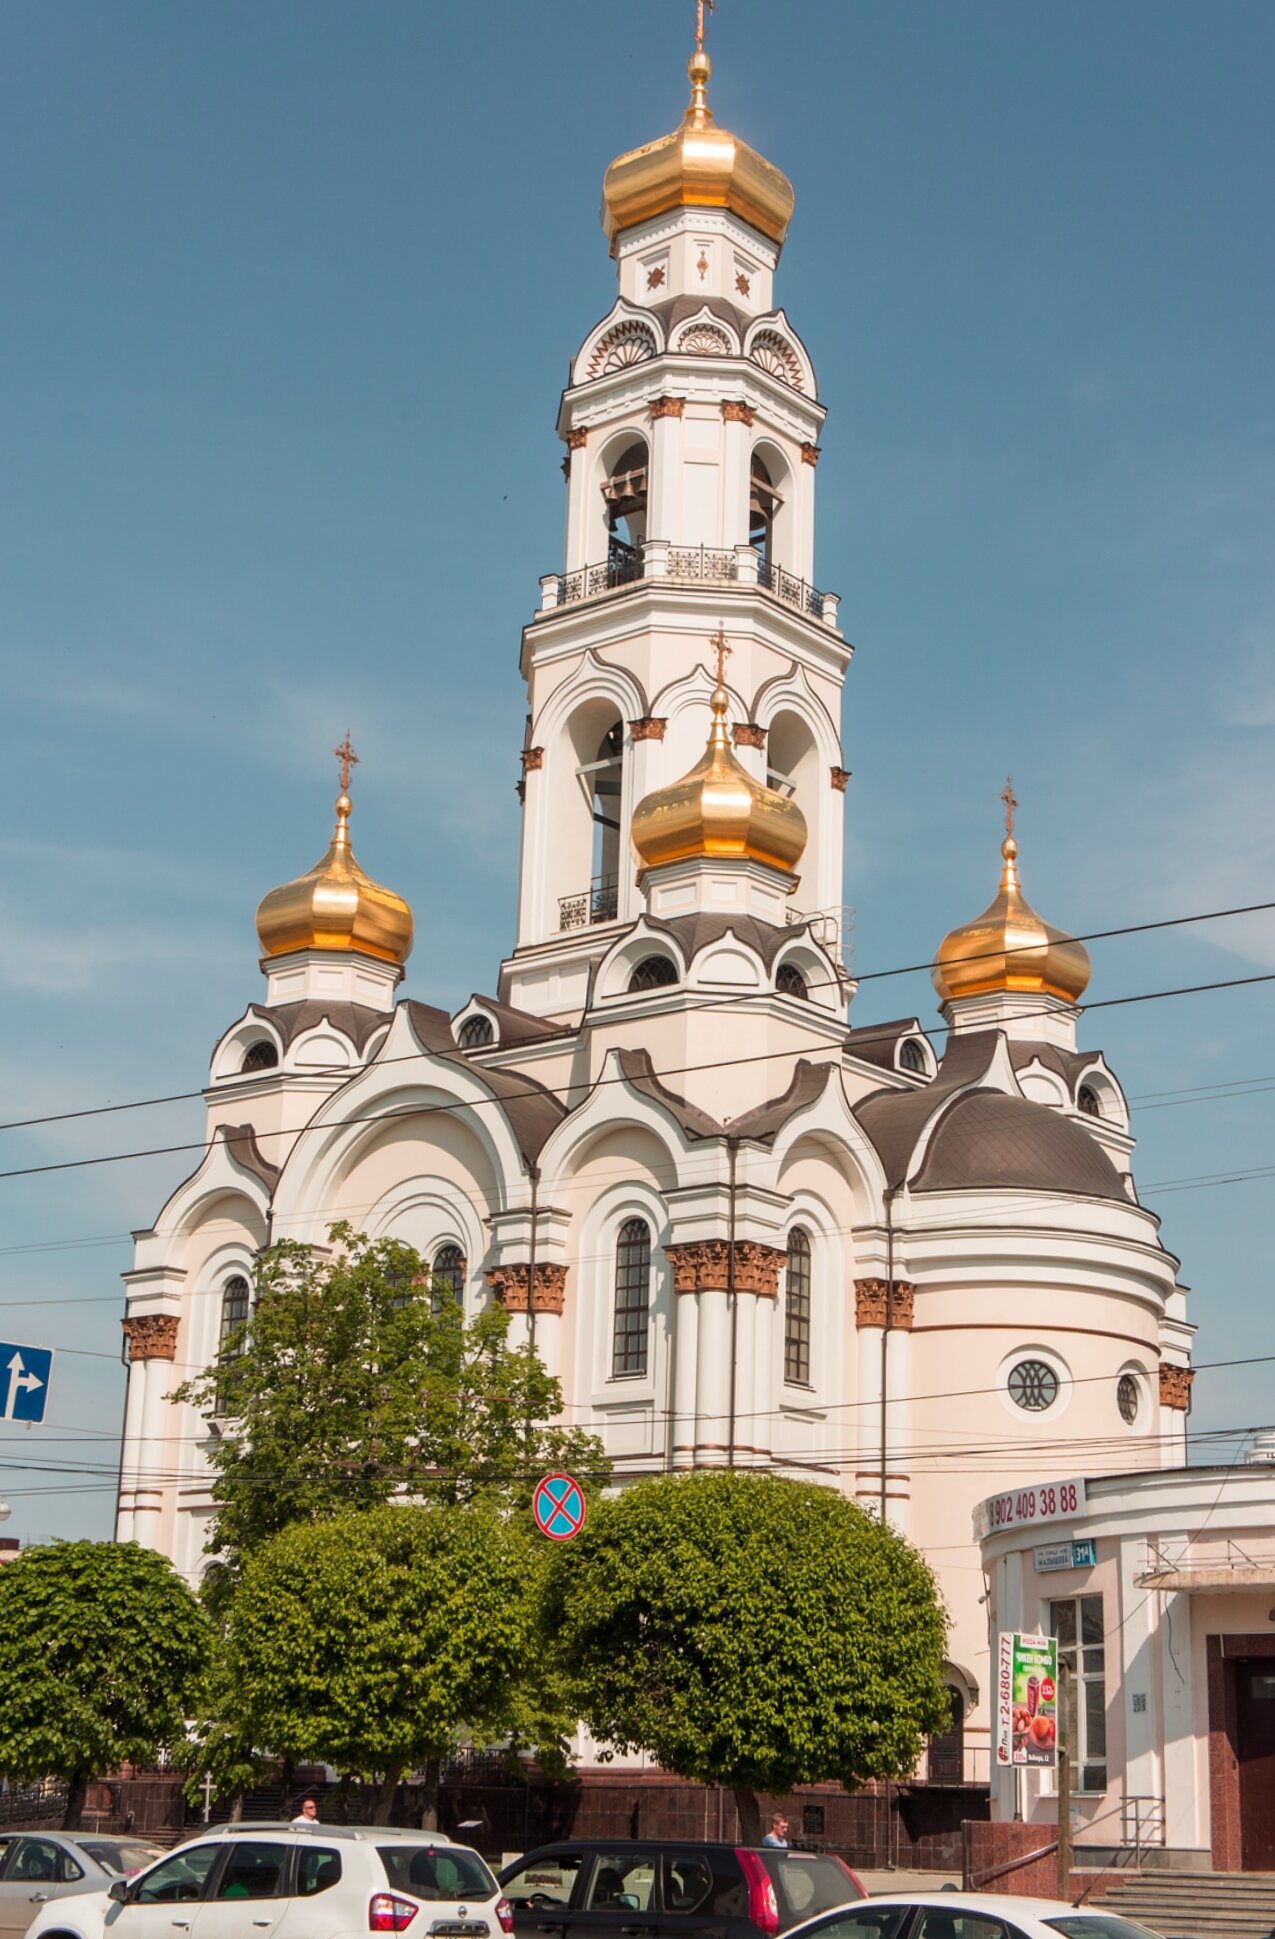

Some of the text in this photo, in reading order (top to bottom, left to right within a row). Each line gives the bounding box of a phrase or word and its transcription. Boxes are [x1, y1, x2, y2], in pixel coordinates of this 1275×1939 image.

[996, 1496, 1013, 1525] 902
[1016, 1491, 1036, 1519] 409
[1040, 1487, 1056, 1516] 38
[1060, 1484, 1077, 1512] 88
